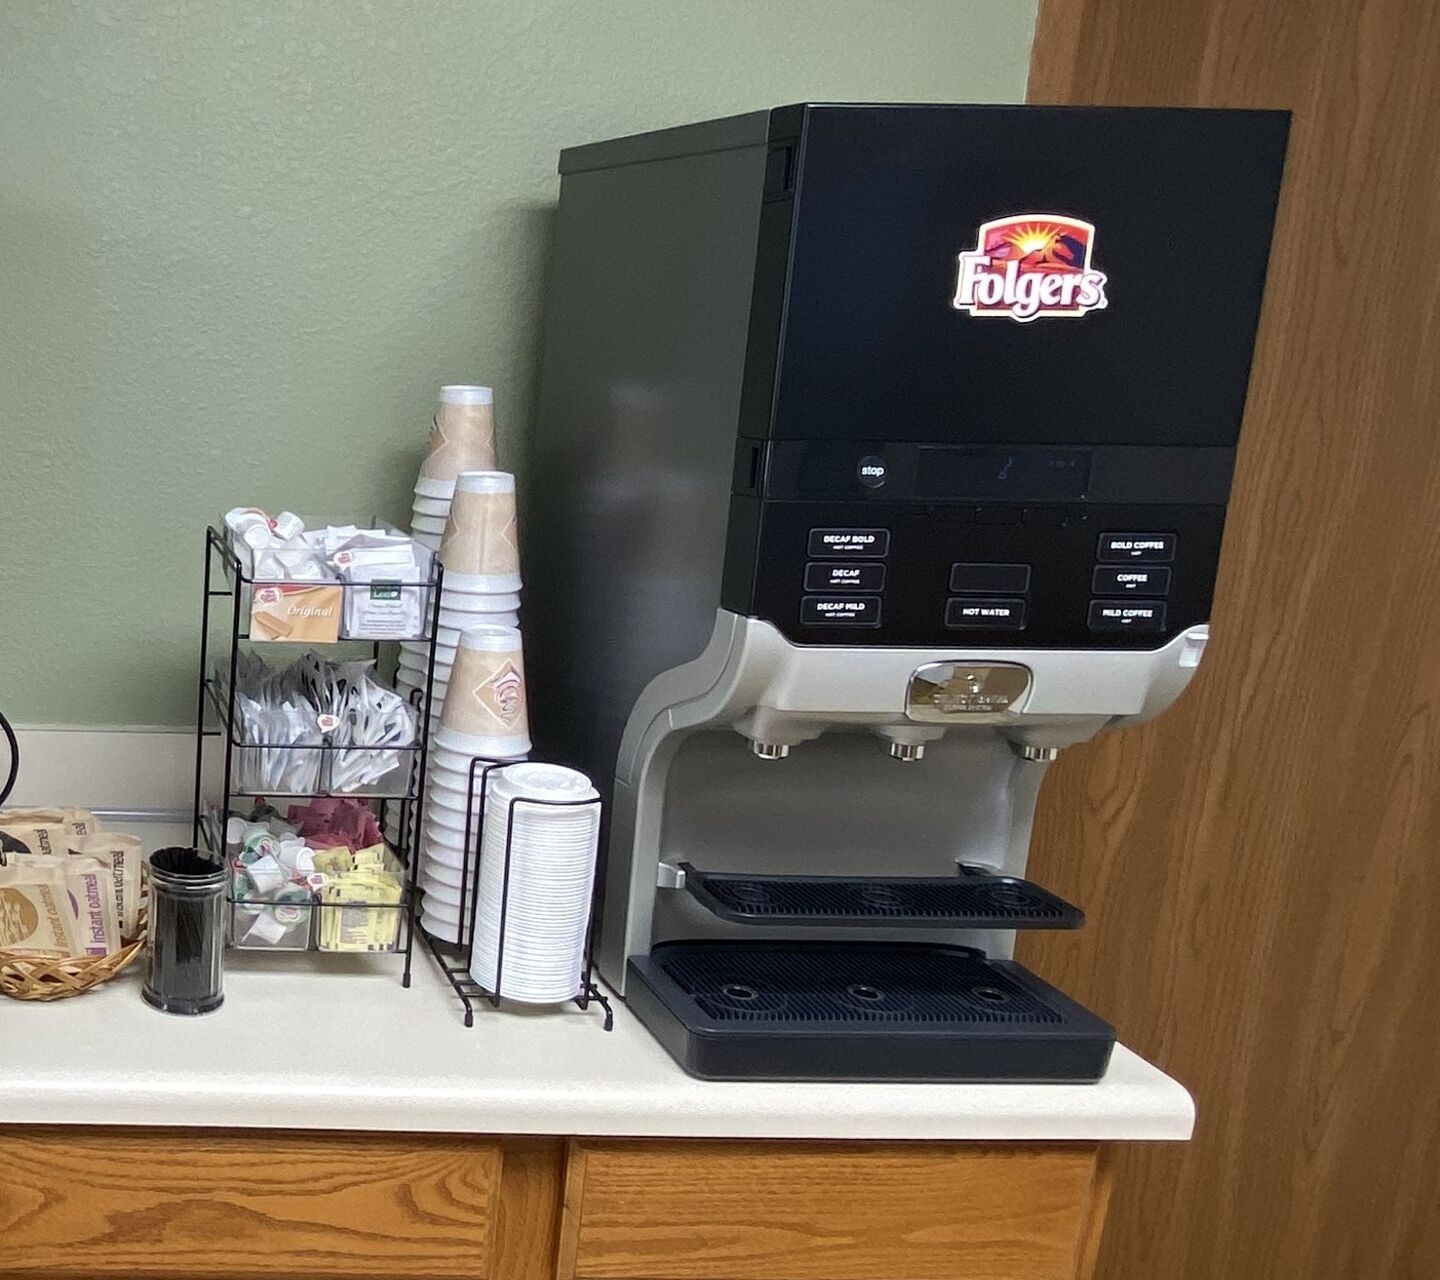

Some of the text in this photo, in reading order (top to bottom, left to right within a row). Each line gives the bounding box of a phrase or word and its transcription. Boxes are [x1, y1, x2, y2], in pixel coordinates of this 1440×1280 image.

[957, 253, 1103, 317] Folgers
[861, 466, 885, 477] stop
[823, 535, 851, 543] DECAF
[832, 569, 860, 577] DECAF
[287, 605, 335, 618] Original
[816, 602, 844, 610] DECAF
[81, 873, 106, 944] instant oatmeal
